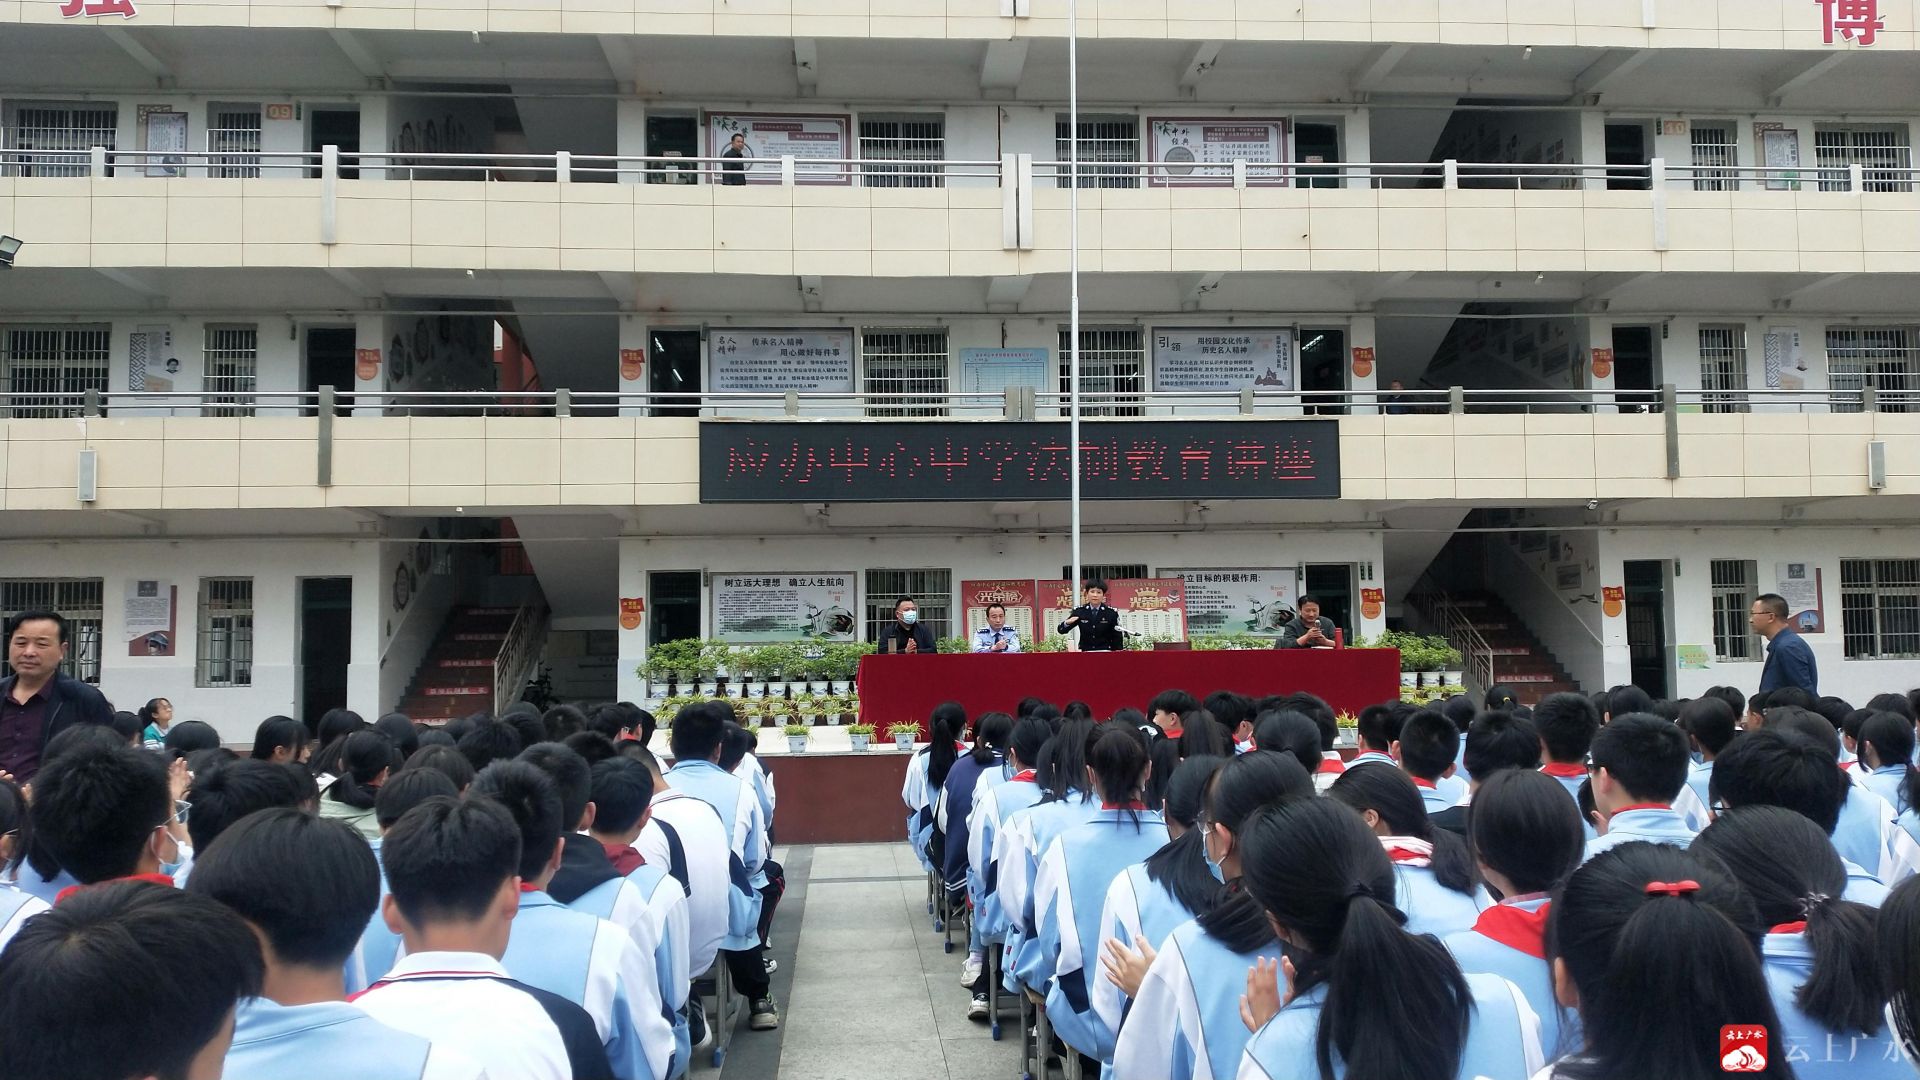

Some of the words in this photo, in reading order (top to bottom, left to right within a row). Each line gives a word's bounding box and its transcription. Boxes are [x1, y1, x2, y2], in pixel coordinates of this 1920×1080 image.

[1815, 0, 1884, 46] 博
[269, 106, 290, 118] 09
[1172, 127, 1189, 136] 中外
[718, 335, 737, 345] 名人
[752, 337, 804, 346] 传承名人精神
[1158, 336, 1181, 351] 引领
[1197, 337, 1251, 345] 用校园文化传承
[717, 346, 737, 355] 精神
[780, 348, 840, 357] 用心做好每件事
[1202, 346, 1248, 354] 历史名人精神
[726, 437, 1316, 483] 应办中心中学法制教育讲座
[724, 578, 781, 588] 树立远大理想
[788, 578, 844, 587] 确立人生航向
[979, 592, 1019, 603] 光荣榜
[1129, 595, 1168, 609] 光荣榜
